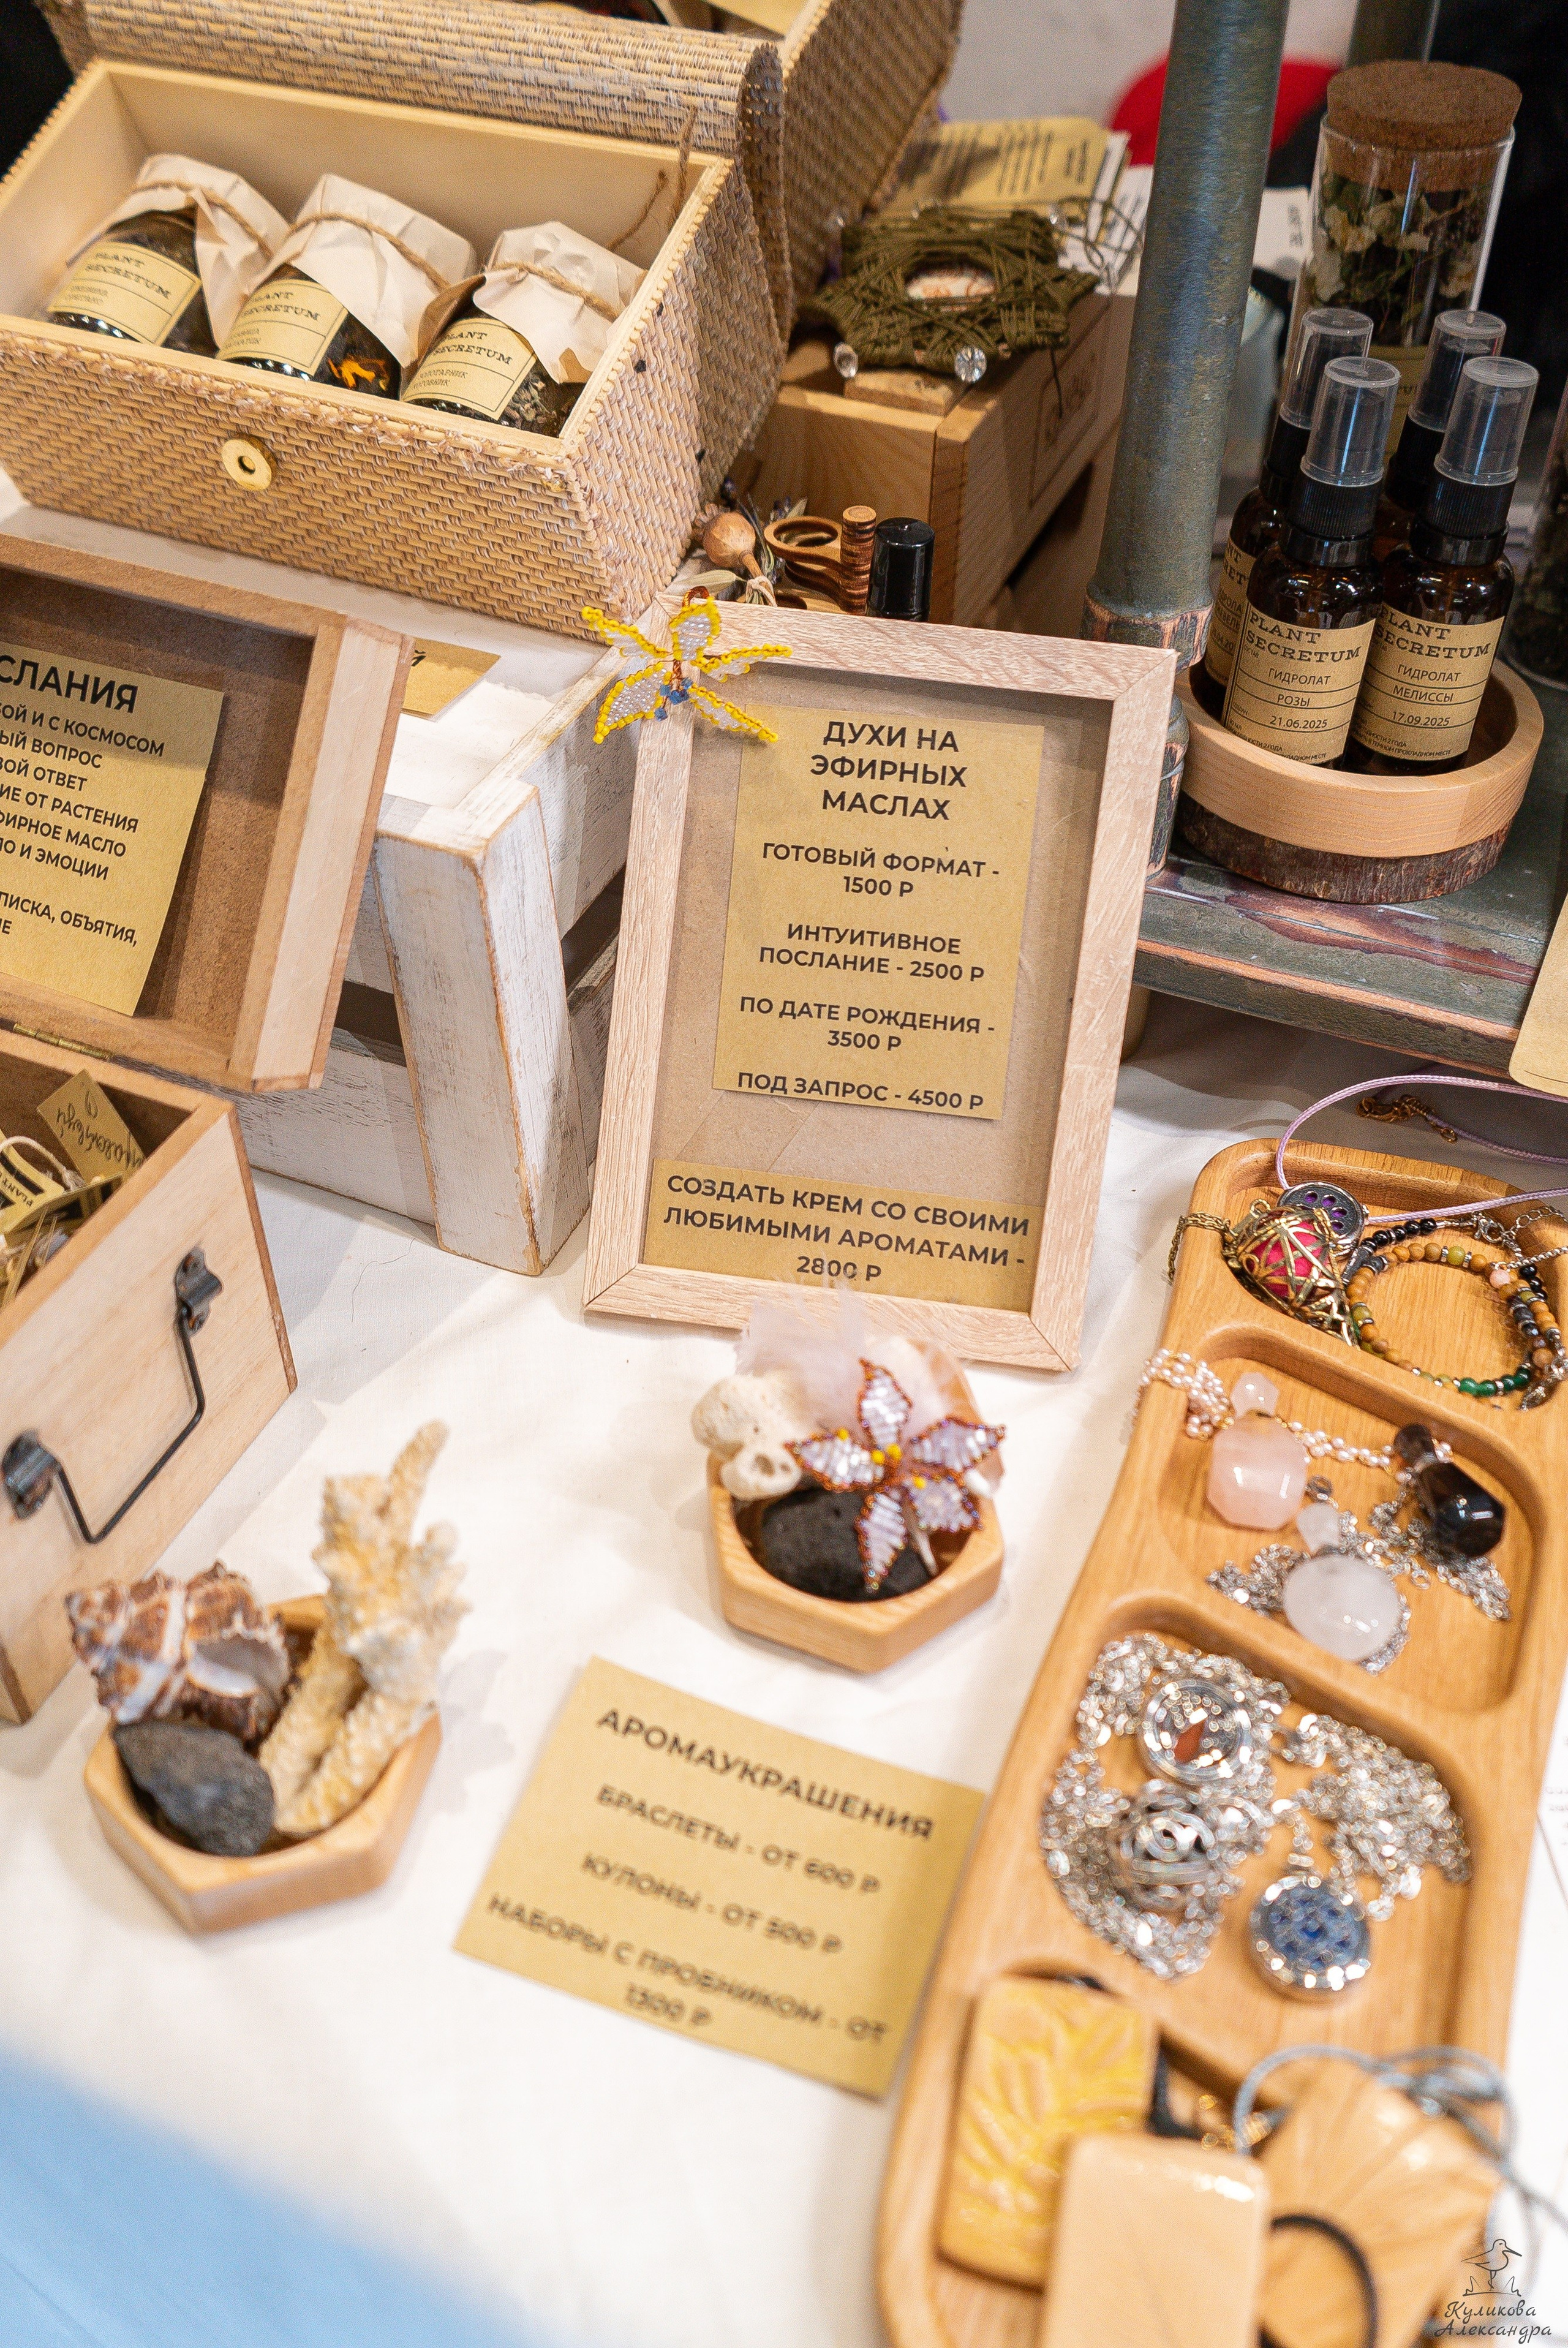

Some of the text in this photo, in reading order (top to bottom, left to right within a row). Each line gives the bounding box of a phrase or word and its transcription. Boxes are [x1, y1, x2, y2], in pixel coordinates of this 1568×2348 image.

[433, 344, 513, 365] SECRETUM
[1249, 612, 1321, 644] PLANT
[1380, 605, 1450, 640] PLANT
[1246, 630, 1362, 663] SECRETUM
[1374, 625, 1491, 659] SECRETUM
[1268, 668, 1332, 685] ГИДРОЛАТ
[1397, 664, 1461, 682] ГИДРОЛАТ
[1277, 693, 1310, 707] РОЗЫ
[1392, 685, 1454, 703] МЕЛИССЫ
[0, 703, 165, 757] ОЙ И С КОСМОСОМ
[1270, 715, 1328, 729] 21.06.2025
[1393, 711, 1450, 727] 17.09.2025
[823, 720, 959, 752] ДУХИ НА
[31, 738, 103, 769] ВОПРОС
[33, 766, 88, 791] ОТВЕТ
[810, 754, 968, 788] ЭФИРНЫХ
[25, 791, 49, 809] ОТ
[51, 797, 139, 833] РАСТЕНИЯ
[821, 790, 951, 820] МАСЛАХ
[65, 828, 127, 858] МАСЛО
[19, 844, 32, 859] И
[35, 848, 109, 880] ЭМОЦИИ
[763, 842, 876, 869] ГОТОВЫЙ
[883, 852, 986, 878] ФОРМАТ
[843, 876, 914, 897] 1500 Р
[60, 910, 138, 948] ОБЪЯТИЯ,
[786, 923, 962, 955] ИНТУИТИВНОЕ
[759, 946, 890, 975] ПОСЛАНИЕ
[909, 960, 963, 981] 2500
[970, 965, 985, 982] Р
[739, 996, 774, 1014] ПО
[778, 1000, 840, 1022] ДАТЕ
[846, 1006, 981, 1034] РОЖДЕНИЯ
[827, 1030, 902, 1051] 3500 Р
[737, 1072, 788, 1094] ПОД
[793, 1077, 888, 1103] ЗАПРОС
[908, 1089, 963, 1109] 4500
[970, 1093, 984, 1110] Р
[667, 1174, 1029, 1237] СОЗДАТЬ КРЕМ СО СВОИМИ
[663, 1206, 831, 1244] ЛЮБИМЫМИ
[837, 1228, 1009, 1267] АРОМАТАМИ
[796, 1256, 882, 1282] 2800 Р
[597, 1708, 935, 1840] АРОМАУКРАШЕНИЯ
[597, 1785, 741, 1852] БРАСЛЕТЫ
[762, 1843, 799, 1868] ОТ
[861, 1874, 881, 1895] Р
[581, 1852, 700, 1911] КУЛОНЫ
[722, 1903, 759, 1928] ОТ
[821, 1933, 842, 1954] Р
[486, 1893, 609, 1955] НАБОРЫ
[614, 1941, 635, 1963] С
[638, 1949, 823, 2027] ПРОБНИКОМ
[846, 2015, 888, 2046] ОТ
